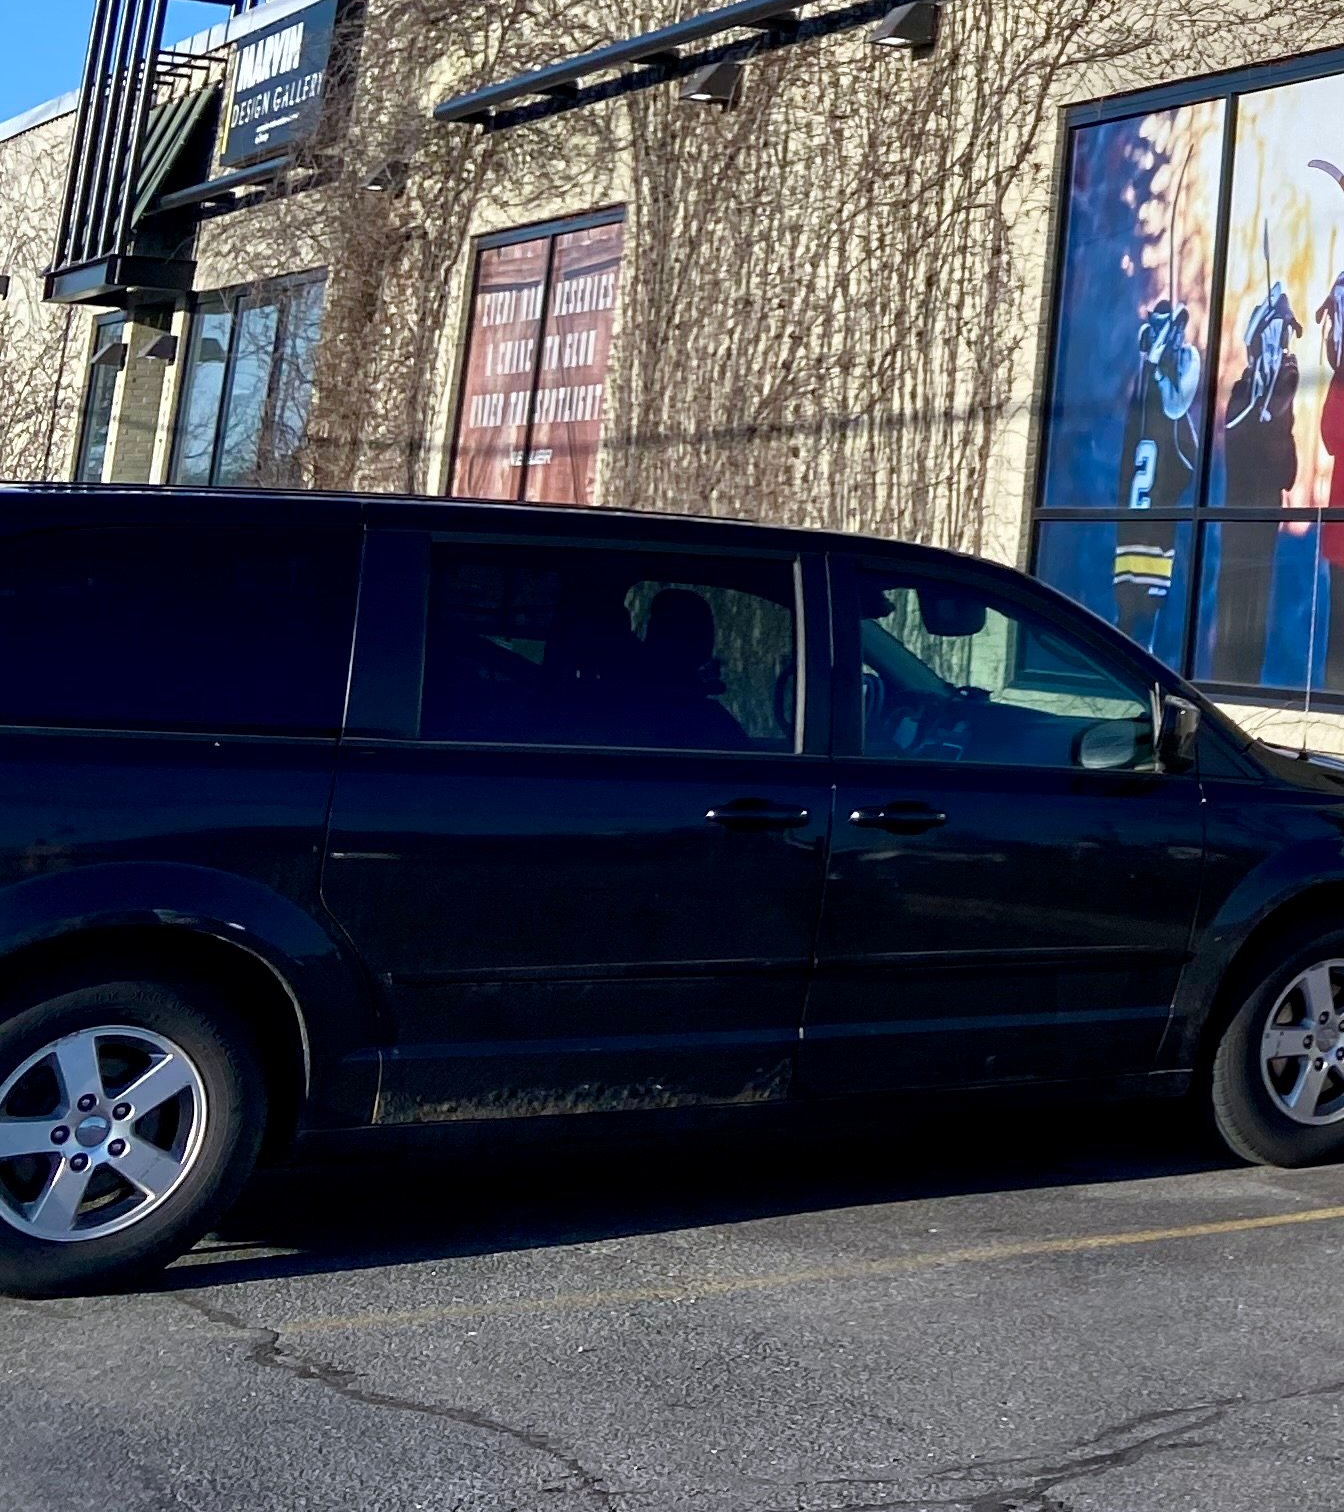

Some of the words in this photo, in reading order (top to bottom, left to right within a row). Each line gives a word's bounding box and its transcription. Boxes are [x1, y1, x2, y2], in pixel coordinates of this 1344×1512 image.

[236, 21, 305, 93] MARVIN
[230, 90, 271, 129] DESIGN
[1128, 439, 1158, 509] 2
